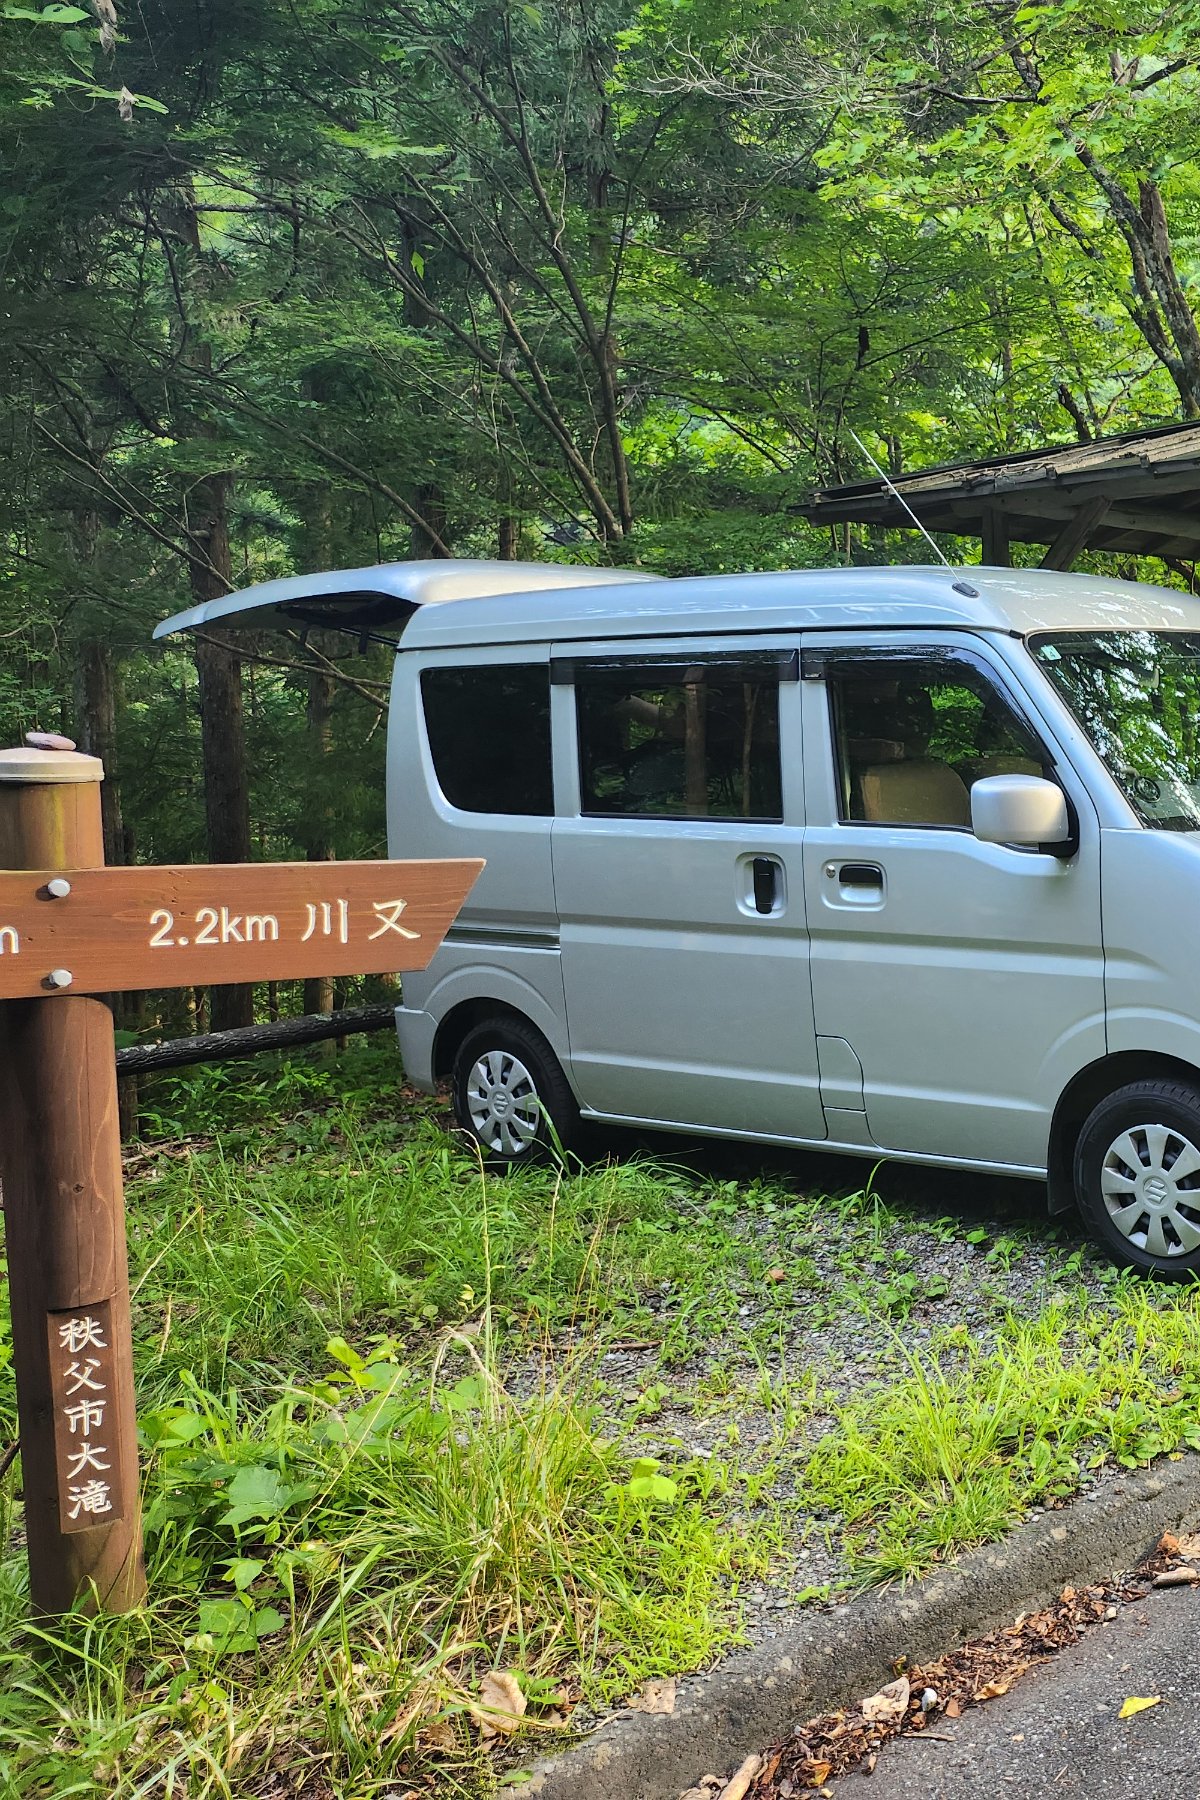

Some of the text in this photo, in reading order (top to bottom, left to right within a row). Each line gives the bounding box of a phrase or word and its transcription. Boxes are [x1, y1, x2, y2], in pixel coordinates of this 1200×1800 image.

[149, 898, 421, 947] 2.2km 川又
[58, 1316, 113, 1520] 秩父市大滝
